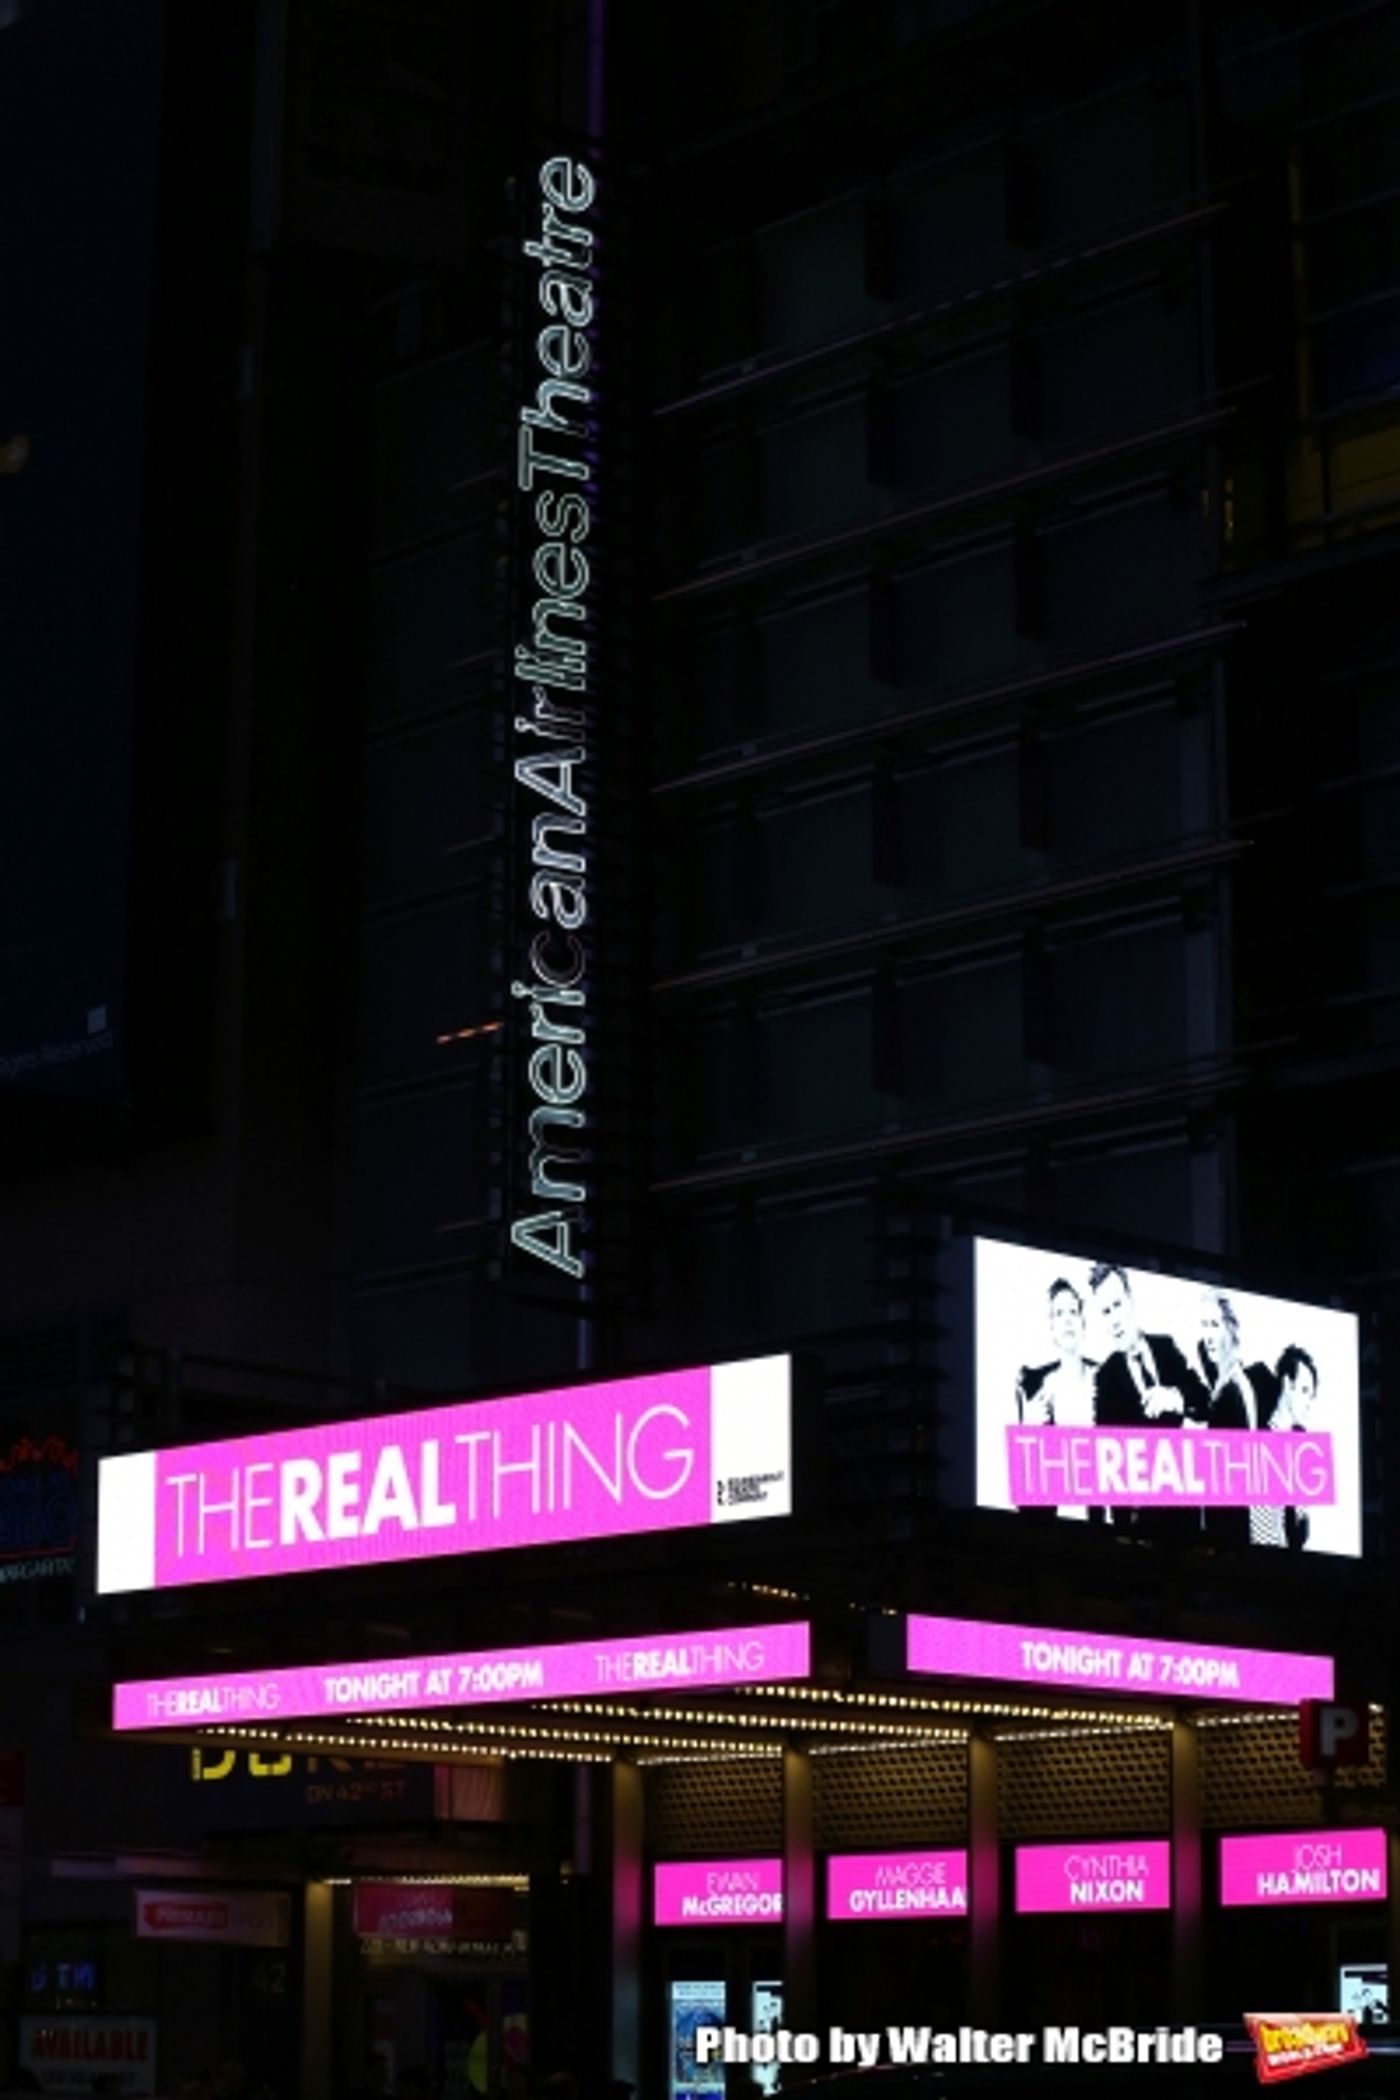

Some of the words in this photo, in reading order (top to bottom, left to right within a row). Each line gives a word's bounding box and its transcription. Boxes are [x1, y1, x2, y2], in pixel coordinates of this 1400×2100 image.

[1021, 1641, 1123, 1679] TONIGHT
[1128, 1652, 1155, 1681] AT
[1160, 1655, 1240, 1689] 7:00PM
[324, 1671, 421, 1703] TONIGHT
[426, 1668, 453, 1696] AT
[458, 1660, 544, 1693] 7:00PM
[1319, 1707, 1359, 1757] P
[1063, 1854, 1149, 1880] CYNTHIA
[1294, 1844, 1343, 1872] JOSH
[874, 1862, 946, 1889] MAGGIE
[1256, 1868, 1381, 1896] HAMILTON
[1070, 1879, 1144, 1905] NIXON
[31, 2029, 150, 2062] AVAILABLE
